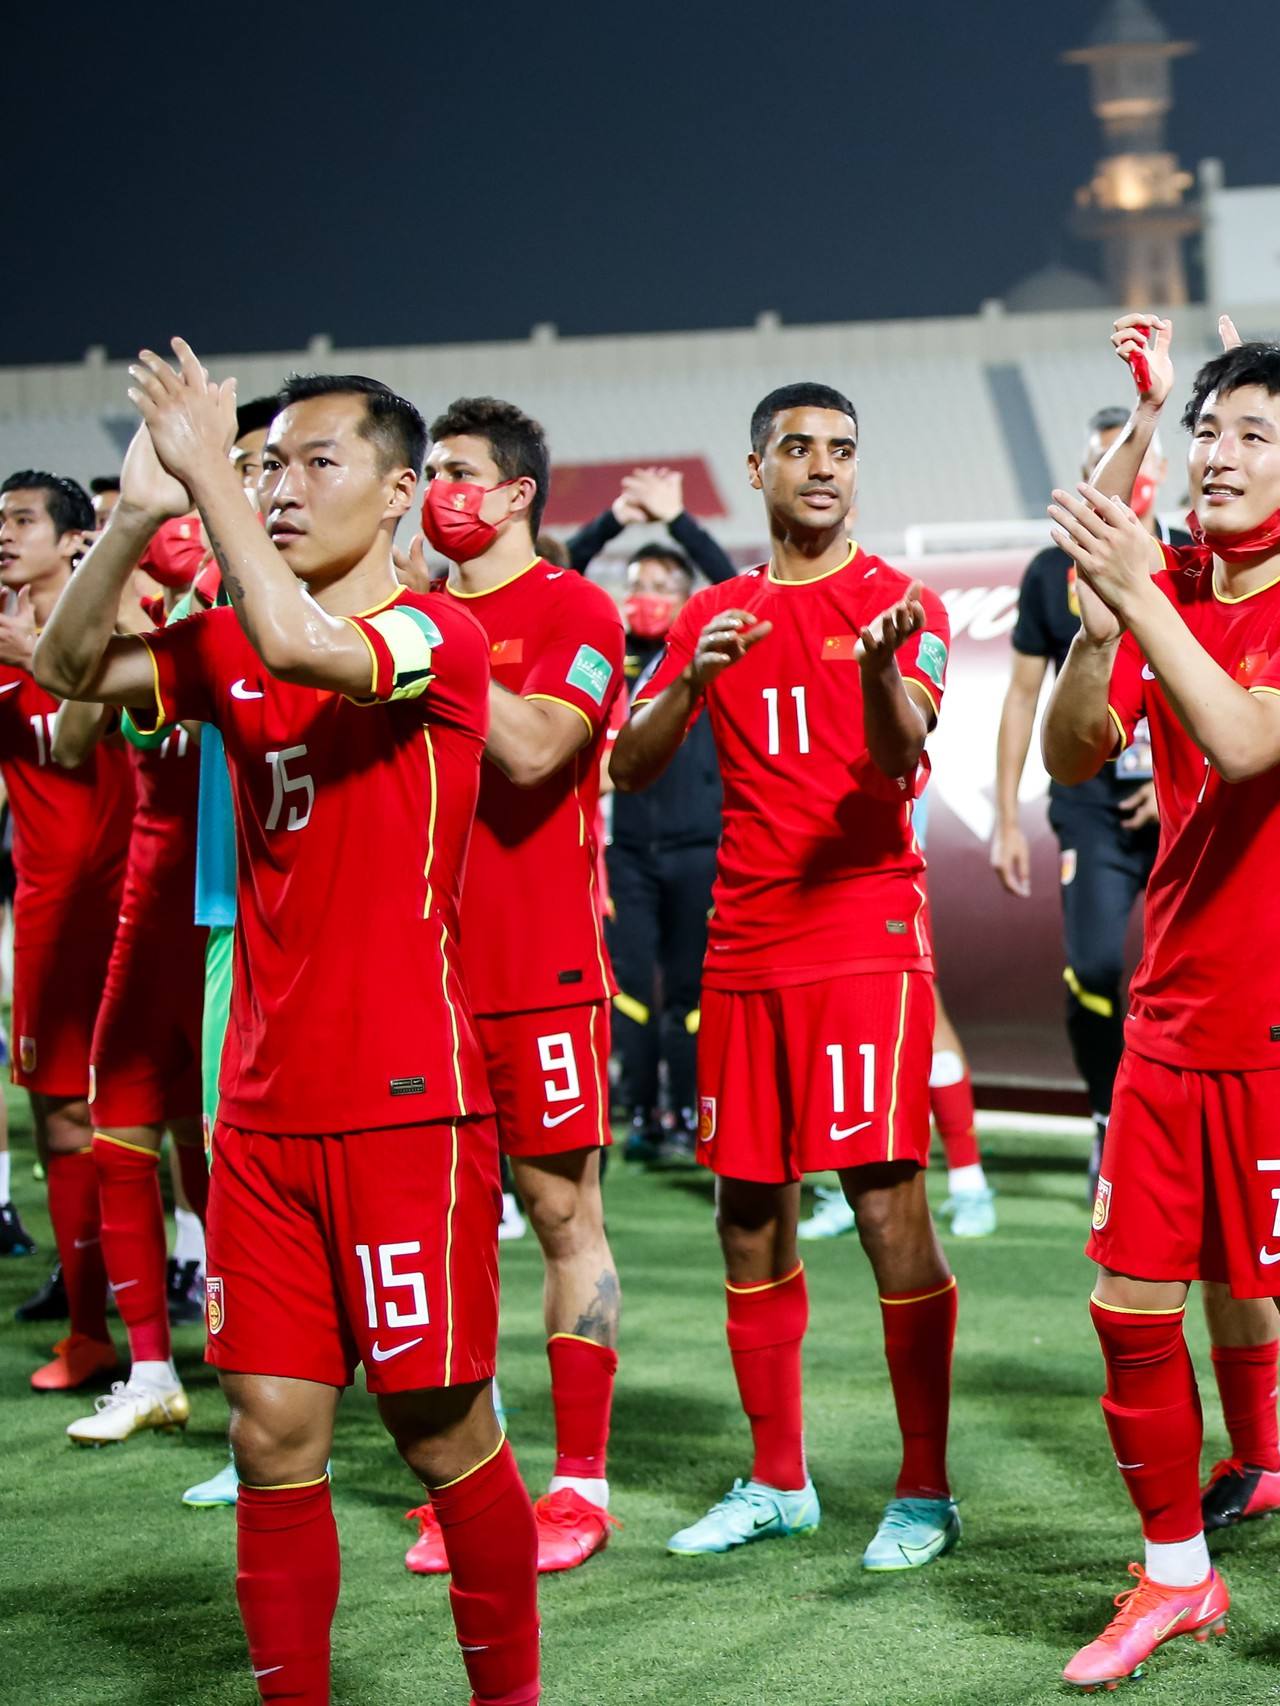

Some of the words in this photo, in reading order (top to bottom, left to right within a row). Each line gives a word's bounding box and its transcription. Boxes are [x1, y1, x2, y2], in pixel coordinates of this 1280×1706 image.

[763, 686, 810, 756] 11
[266, 744, 314, 831] 15
[537, 1032, 581, 1103] 9
[826, 1044, 876, 1113] 11
[356, 1241, 430, 1329] 15
